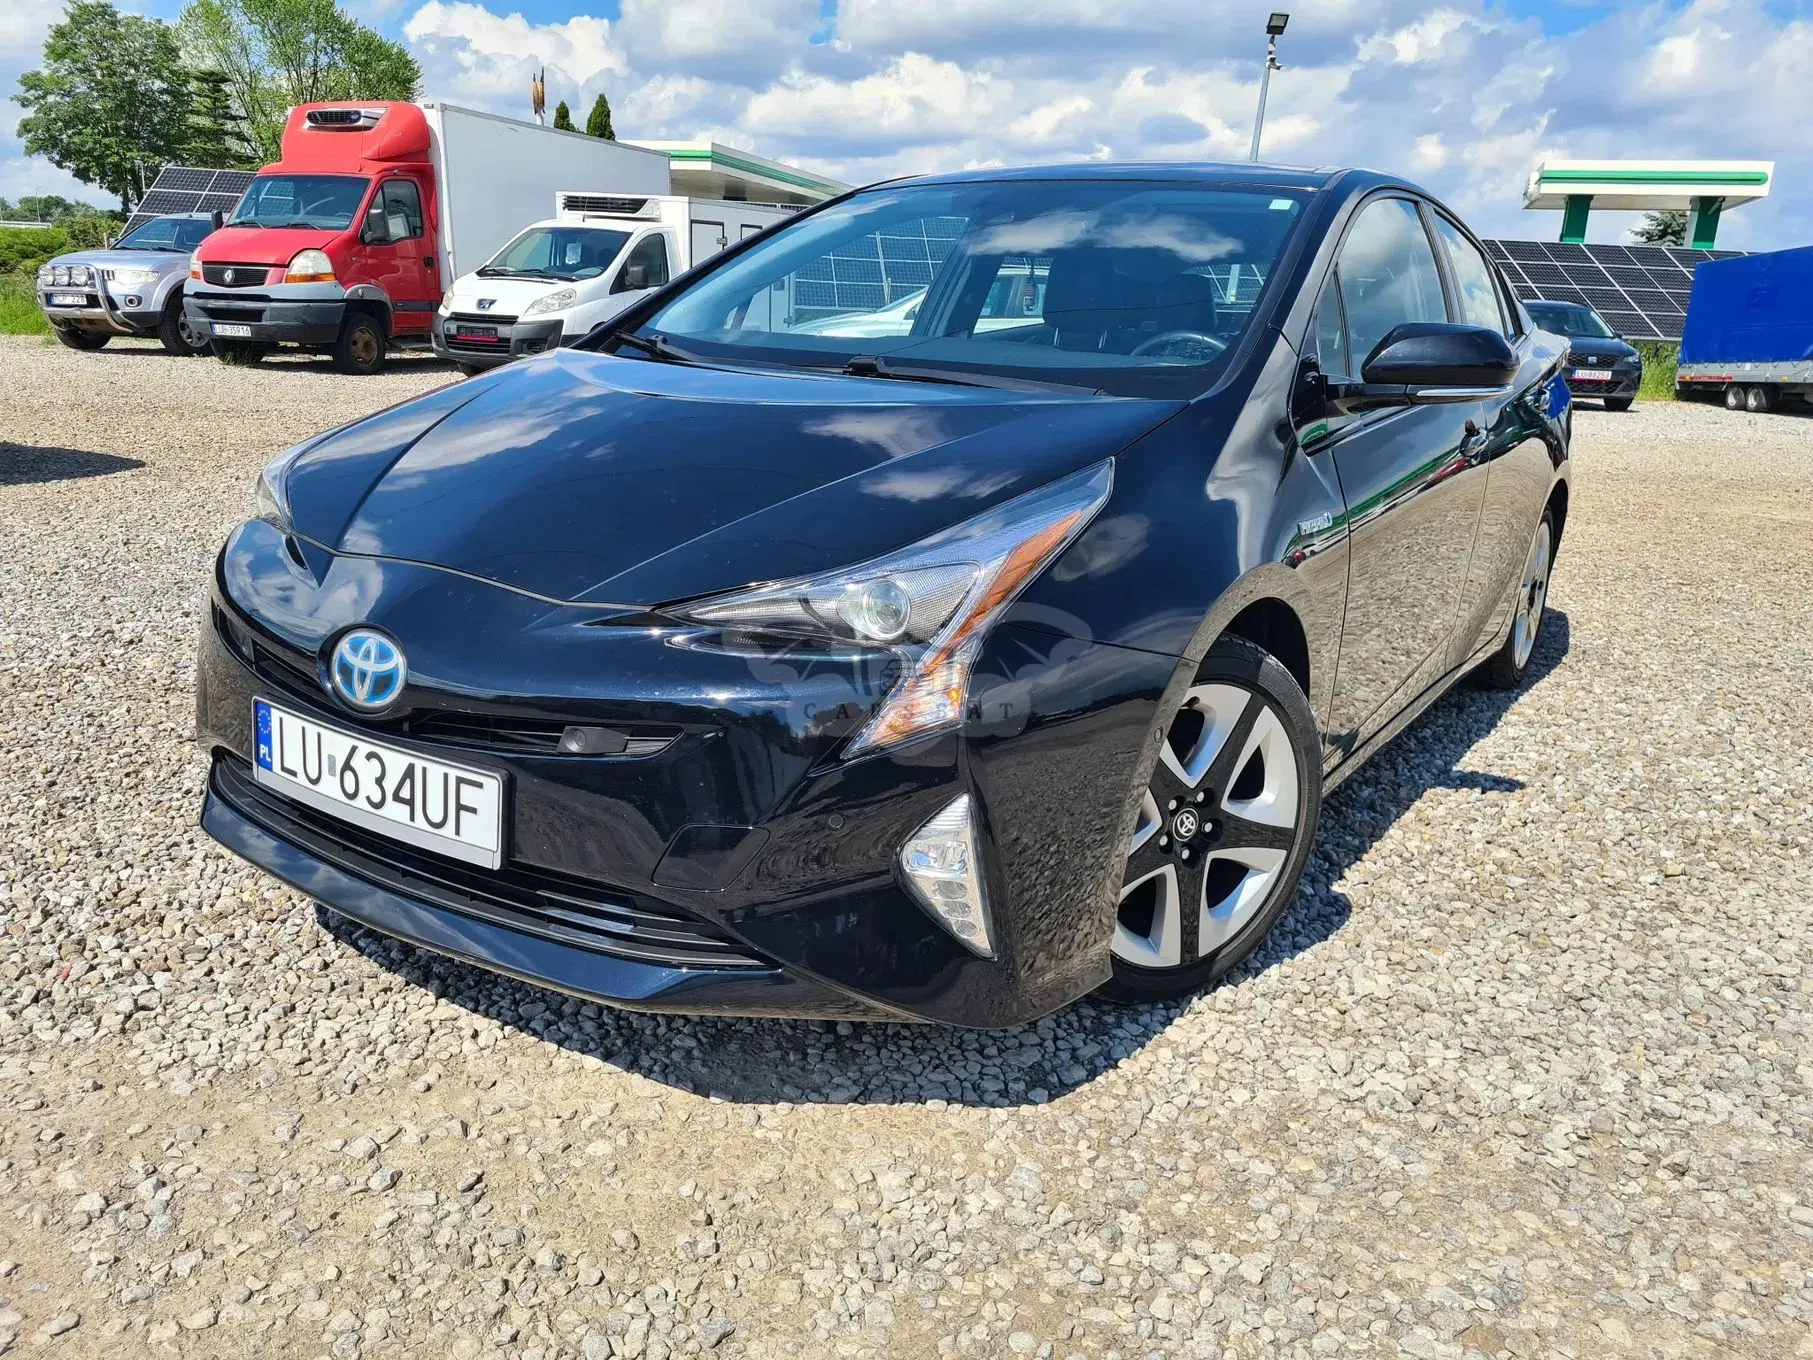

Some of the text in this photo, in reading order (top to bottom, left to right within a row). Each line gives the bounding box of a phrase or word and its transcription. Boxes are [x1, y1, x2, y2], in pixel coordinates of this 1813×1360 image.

[260, 744, 273, 763] PL
[279, 716, 484, 837] LU 634UF
